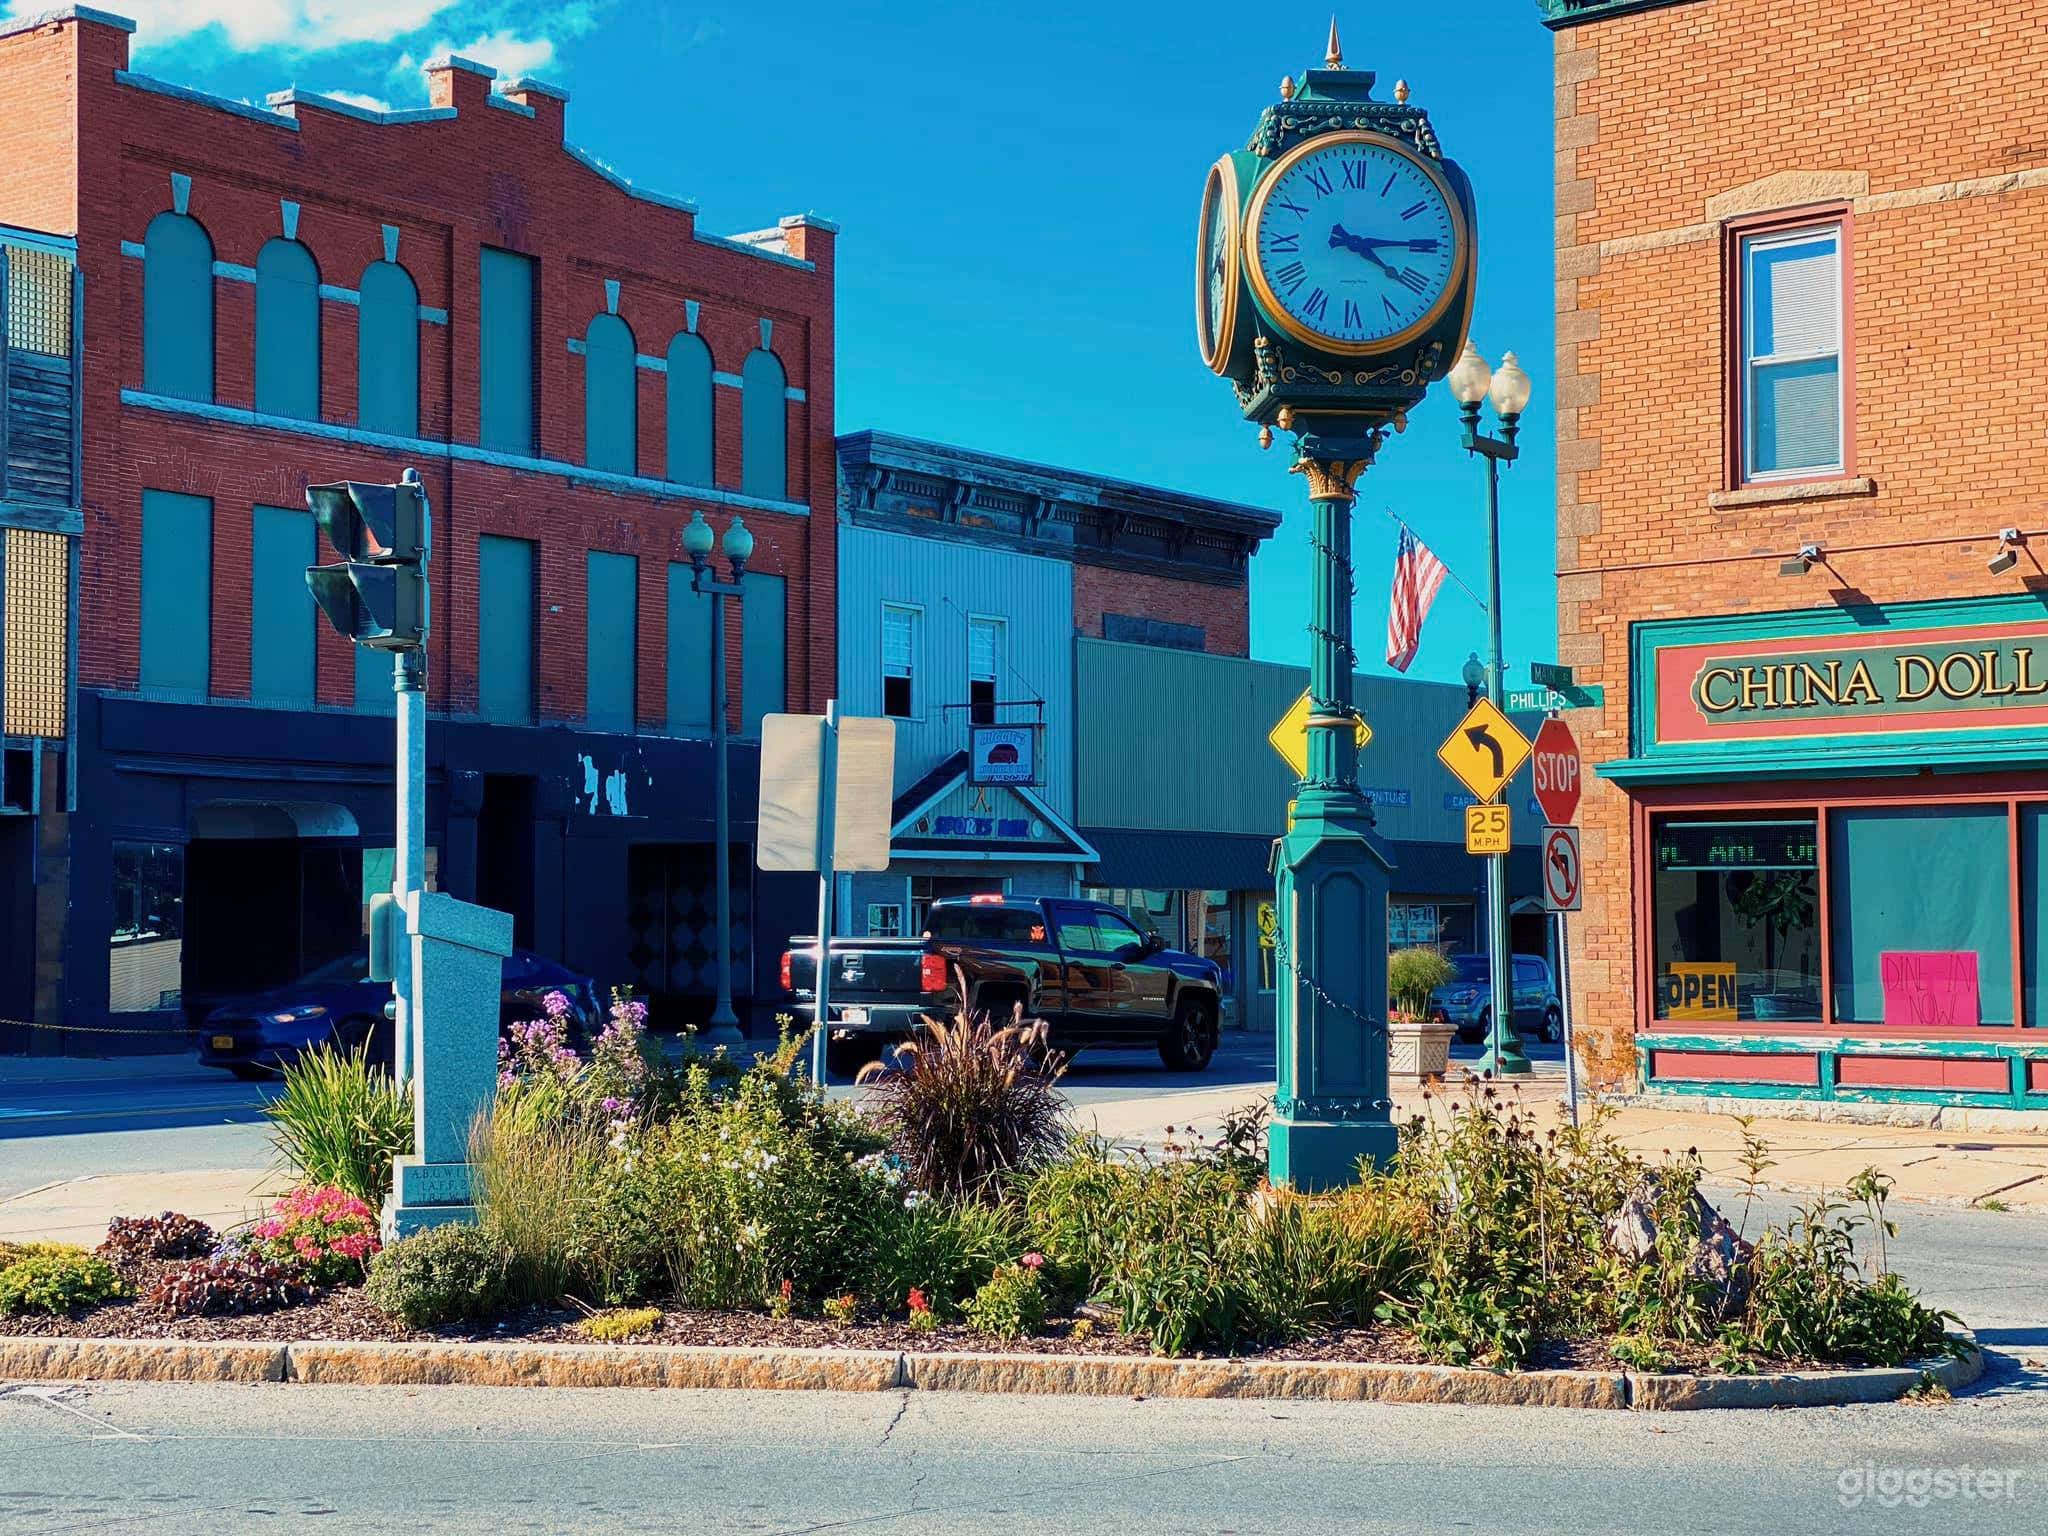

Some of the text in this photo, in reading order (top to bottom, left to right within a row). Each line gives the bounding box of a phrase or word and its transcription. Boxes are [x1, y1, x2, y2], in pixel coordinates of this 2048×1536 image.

[1305, 166, 1333, 200] XI
[1341, 159, 1367, 190] XII
[1279, 196, 1309, 220] X
[1270, 233, 1299, 253] IX
[1534, 665, 1556, 684] MAIN
[1699, 648, 2048, 713] CHINA DOLL
[1510, 690, 1566, 709] PHILLIPS
[1537, 751, 1578, 793] STOP
[1364, 791, 1407, 804] URNITURE
[935, 816, 992, 836] SPORTS
[1470, 811, 1506, 834] 25
[1665, 973, 1736, 1009] OPEN
